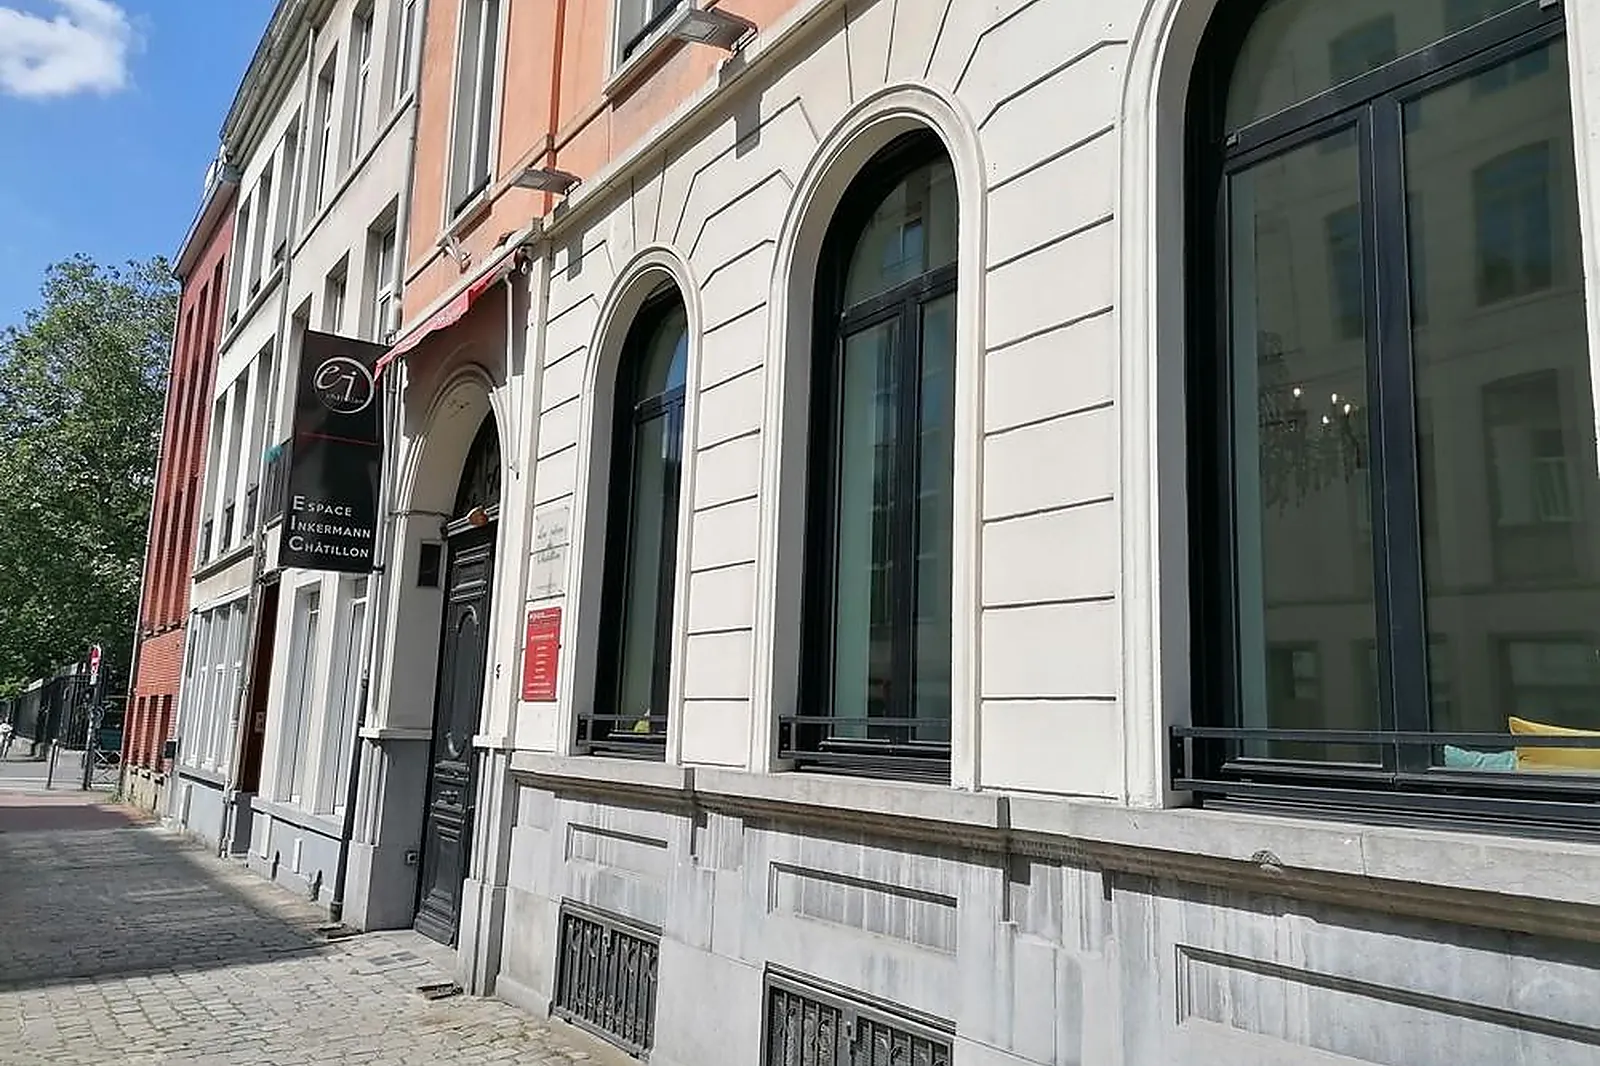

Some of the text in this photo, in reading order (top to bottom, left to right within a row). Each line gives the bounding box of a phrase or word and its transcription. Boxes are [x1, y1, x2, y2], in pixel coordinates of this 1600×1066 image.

[293, 495, 353, 517] ESPACE
[291, 515, 371, 539] INKERMANN
[289, 535, 369, 558] CHÂTILLON
